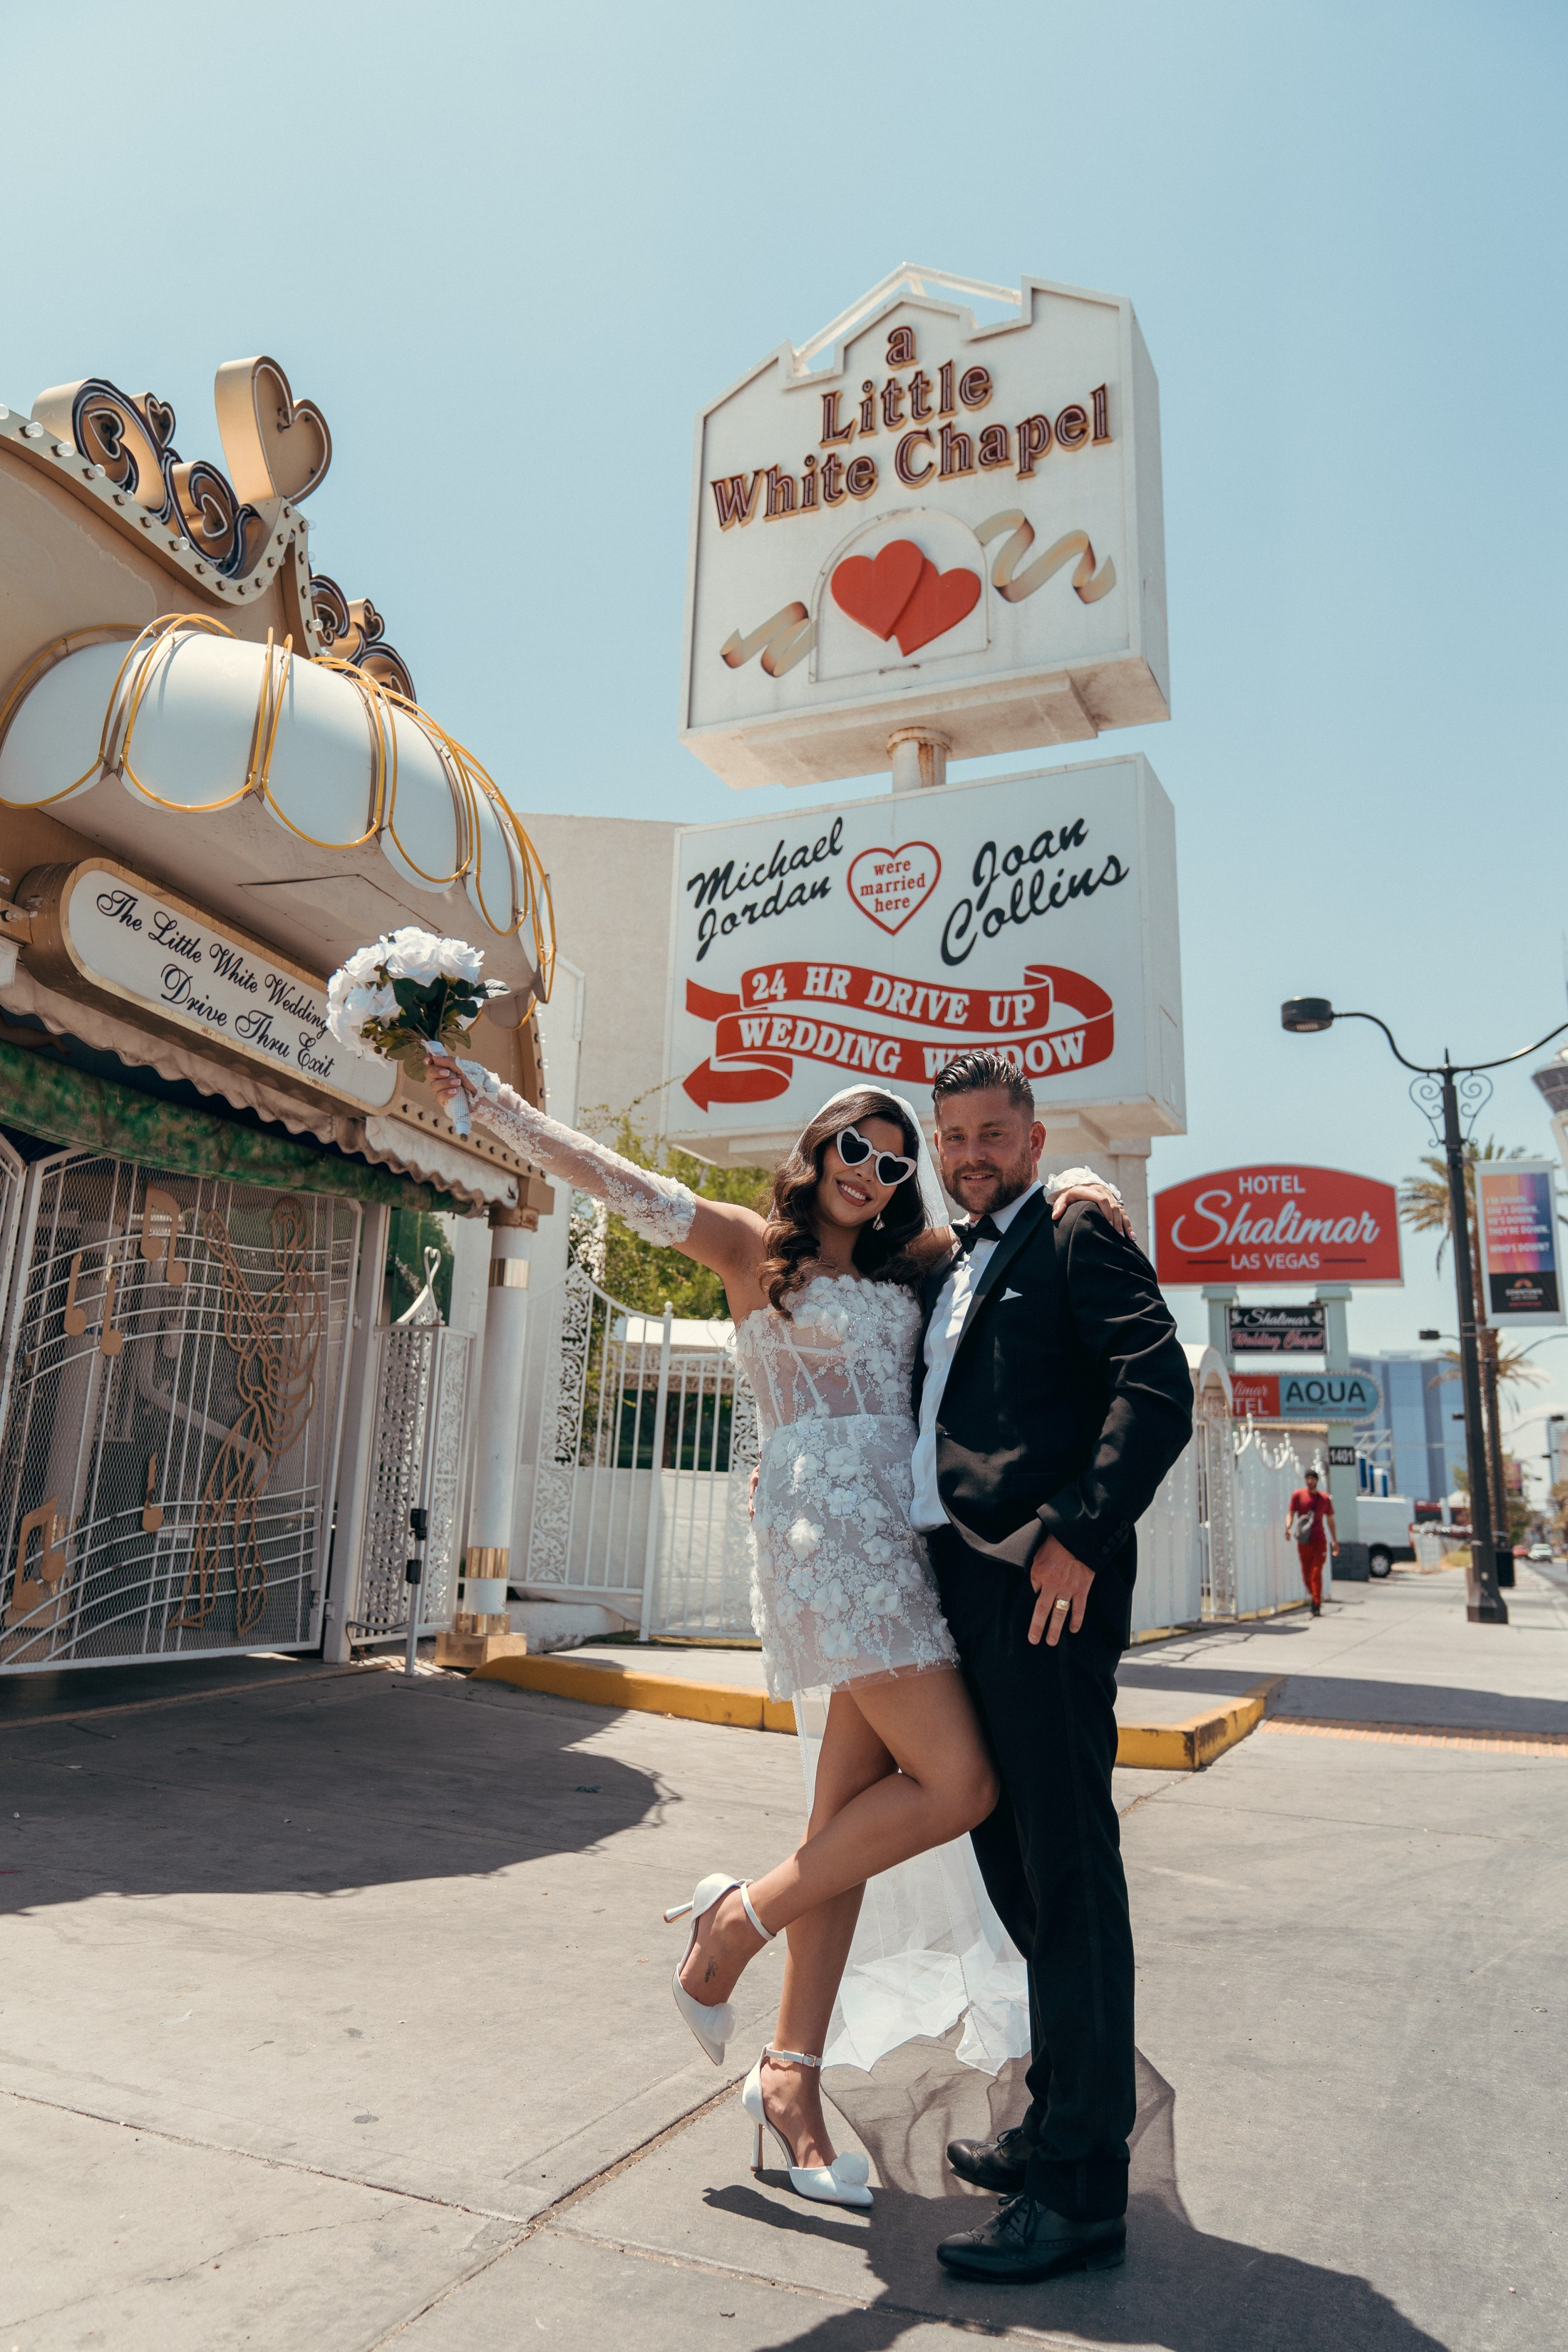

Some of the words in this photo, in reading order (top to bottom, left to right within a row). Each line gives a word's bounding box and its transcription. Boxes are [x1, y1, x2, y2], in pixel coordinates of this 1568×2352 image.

[886, 325, 918, 370] a
[819, 359, 992, 449] Little
[710, 453, 878, 532] White
[894, 383, 1113, 480] Chapel
[687, 816, 843, 909] Michael
[860, 872, 926, 897] married
[874, 860, 911, 876] were
[972, 817, 1089, 912] Joan
[696, 876, 832, 962] Jordan
[875, 897, 910, 913] here
[940, 854, 1130, 966] Collins
[96, 889, 143, 932] The
[148, 911, 202, 963] Little
[210, 943, 258, 994] White
[264, 974, 329, 1040] Wedding
[160, 964, 227, 1026] Drive
[235, 1009, 290, 1058] Thru
[297, 1031, 335, 1078] Exit
[751, 969, 788, 1001] 24
[803, 966, 852, 1000] HR
[863, 975, 971, 1026] DRIVE
[988, 994, 1036, 1028] UP
[738, 1017, 902, 1073] WEDDING
[922, 1029, 1086, 1079] WDOW
[1239, 1175, 1306, 1195] HOTEL
[1171, 1189, 1381, 1253] Shalimar
[1231, 1253, 1261, 1270] LAS
[1264, 1252, 1320, 1270] VEGAS
[1244, 1308, 1311, 1327] Shalimar
[1232, 1380, 1269, 1398] limar
[1232, 1397, 1270, 1415] TEL
[1286, 1381, 1366, 1405] AQUA
[1329, 1448, 1354, 1462] 1401
